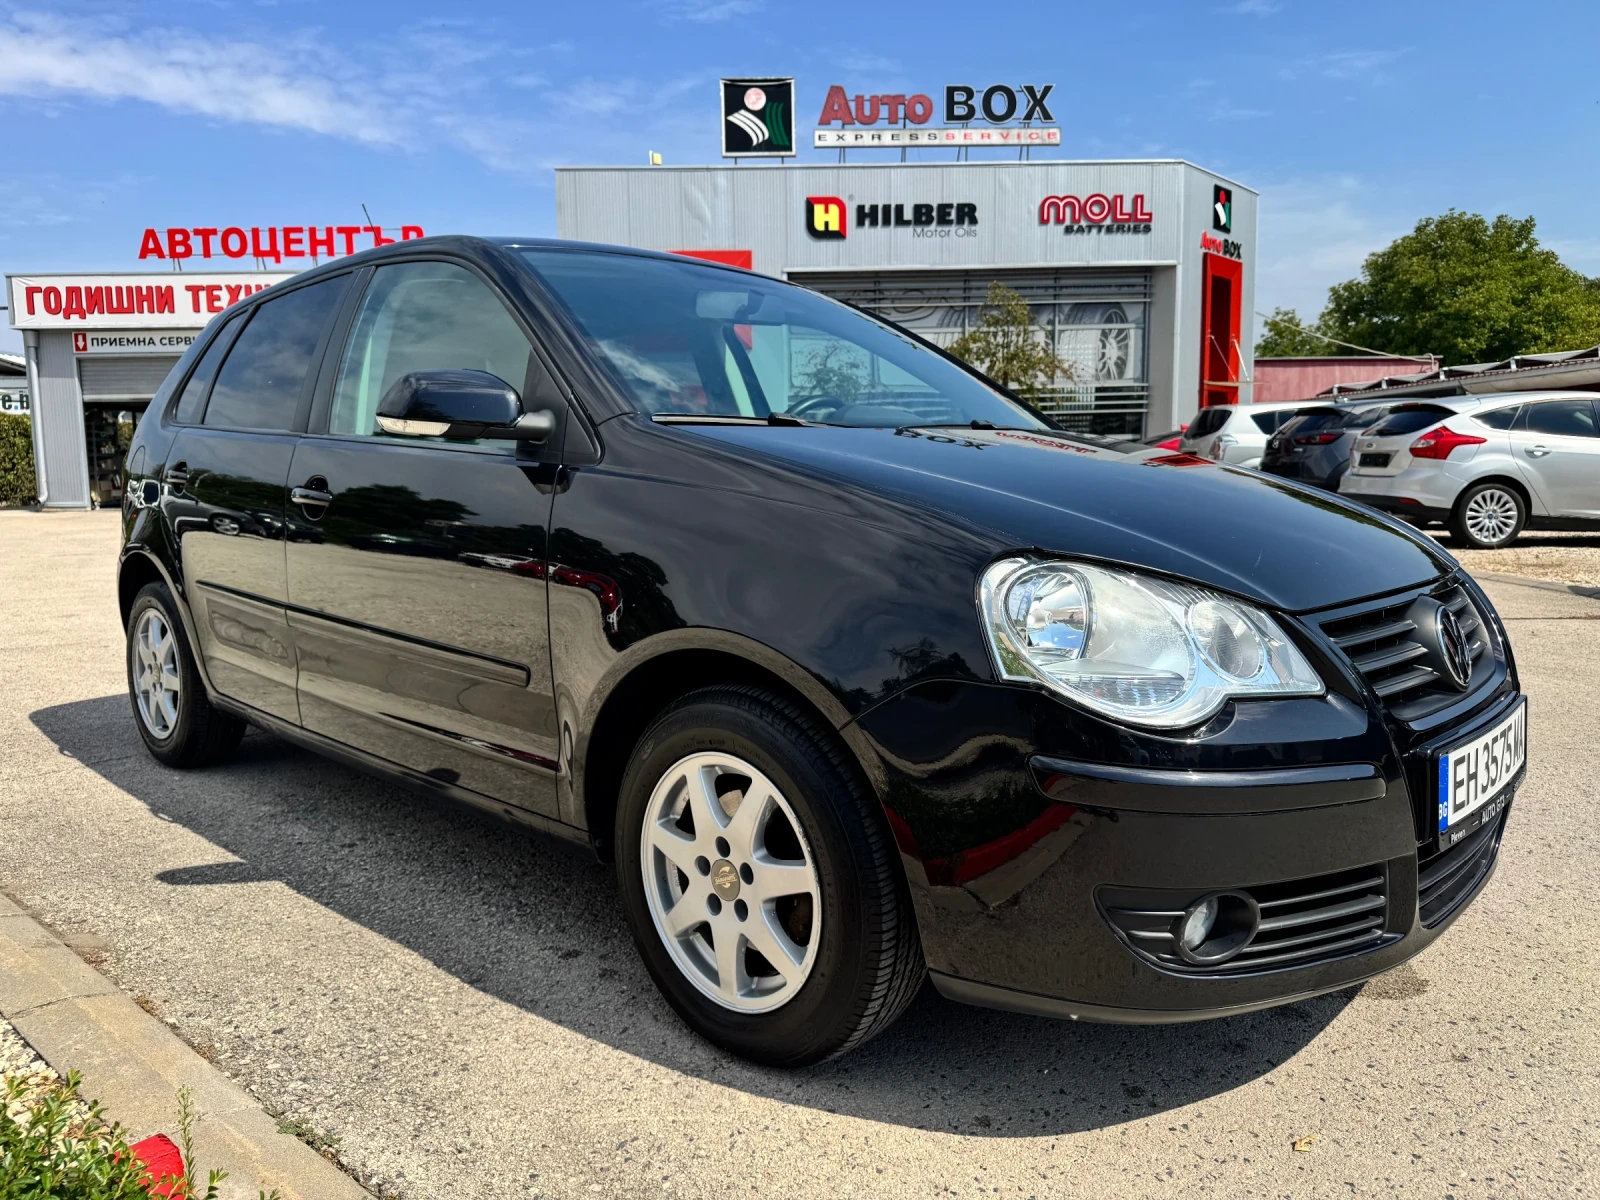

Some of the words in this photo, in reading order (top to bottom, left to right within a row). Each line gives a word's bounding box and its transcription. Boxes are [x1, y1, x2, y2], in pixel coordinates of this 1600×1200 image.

[943, 84, 1056, 124] BOX
[856, 203, 978, 227] HILBER
[913, 228, 951, 238] Motor
[955, 227, 977, 238] Oils
[1064, 224, 1152, 235] BATTERIES
[1222, 239, 1242, 260] BOX
[25, 285, 175, 319] ГОДИШНИ
[91, 337, 156, 347] ПРИЕМНА
[160, 336, 196, 346] СЕРВ
[1439, 801, 1448, 820] BG
[1482, 803, 1496, 825] AUTO
